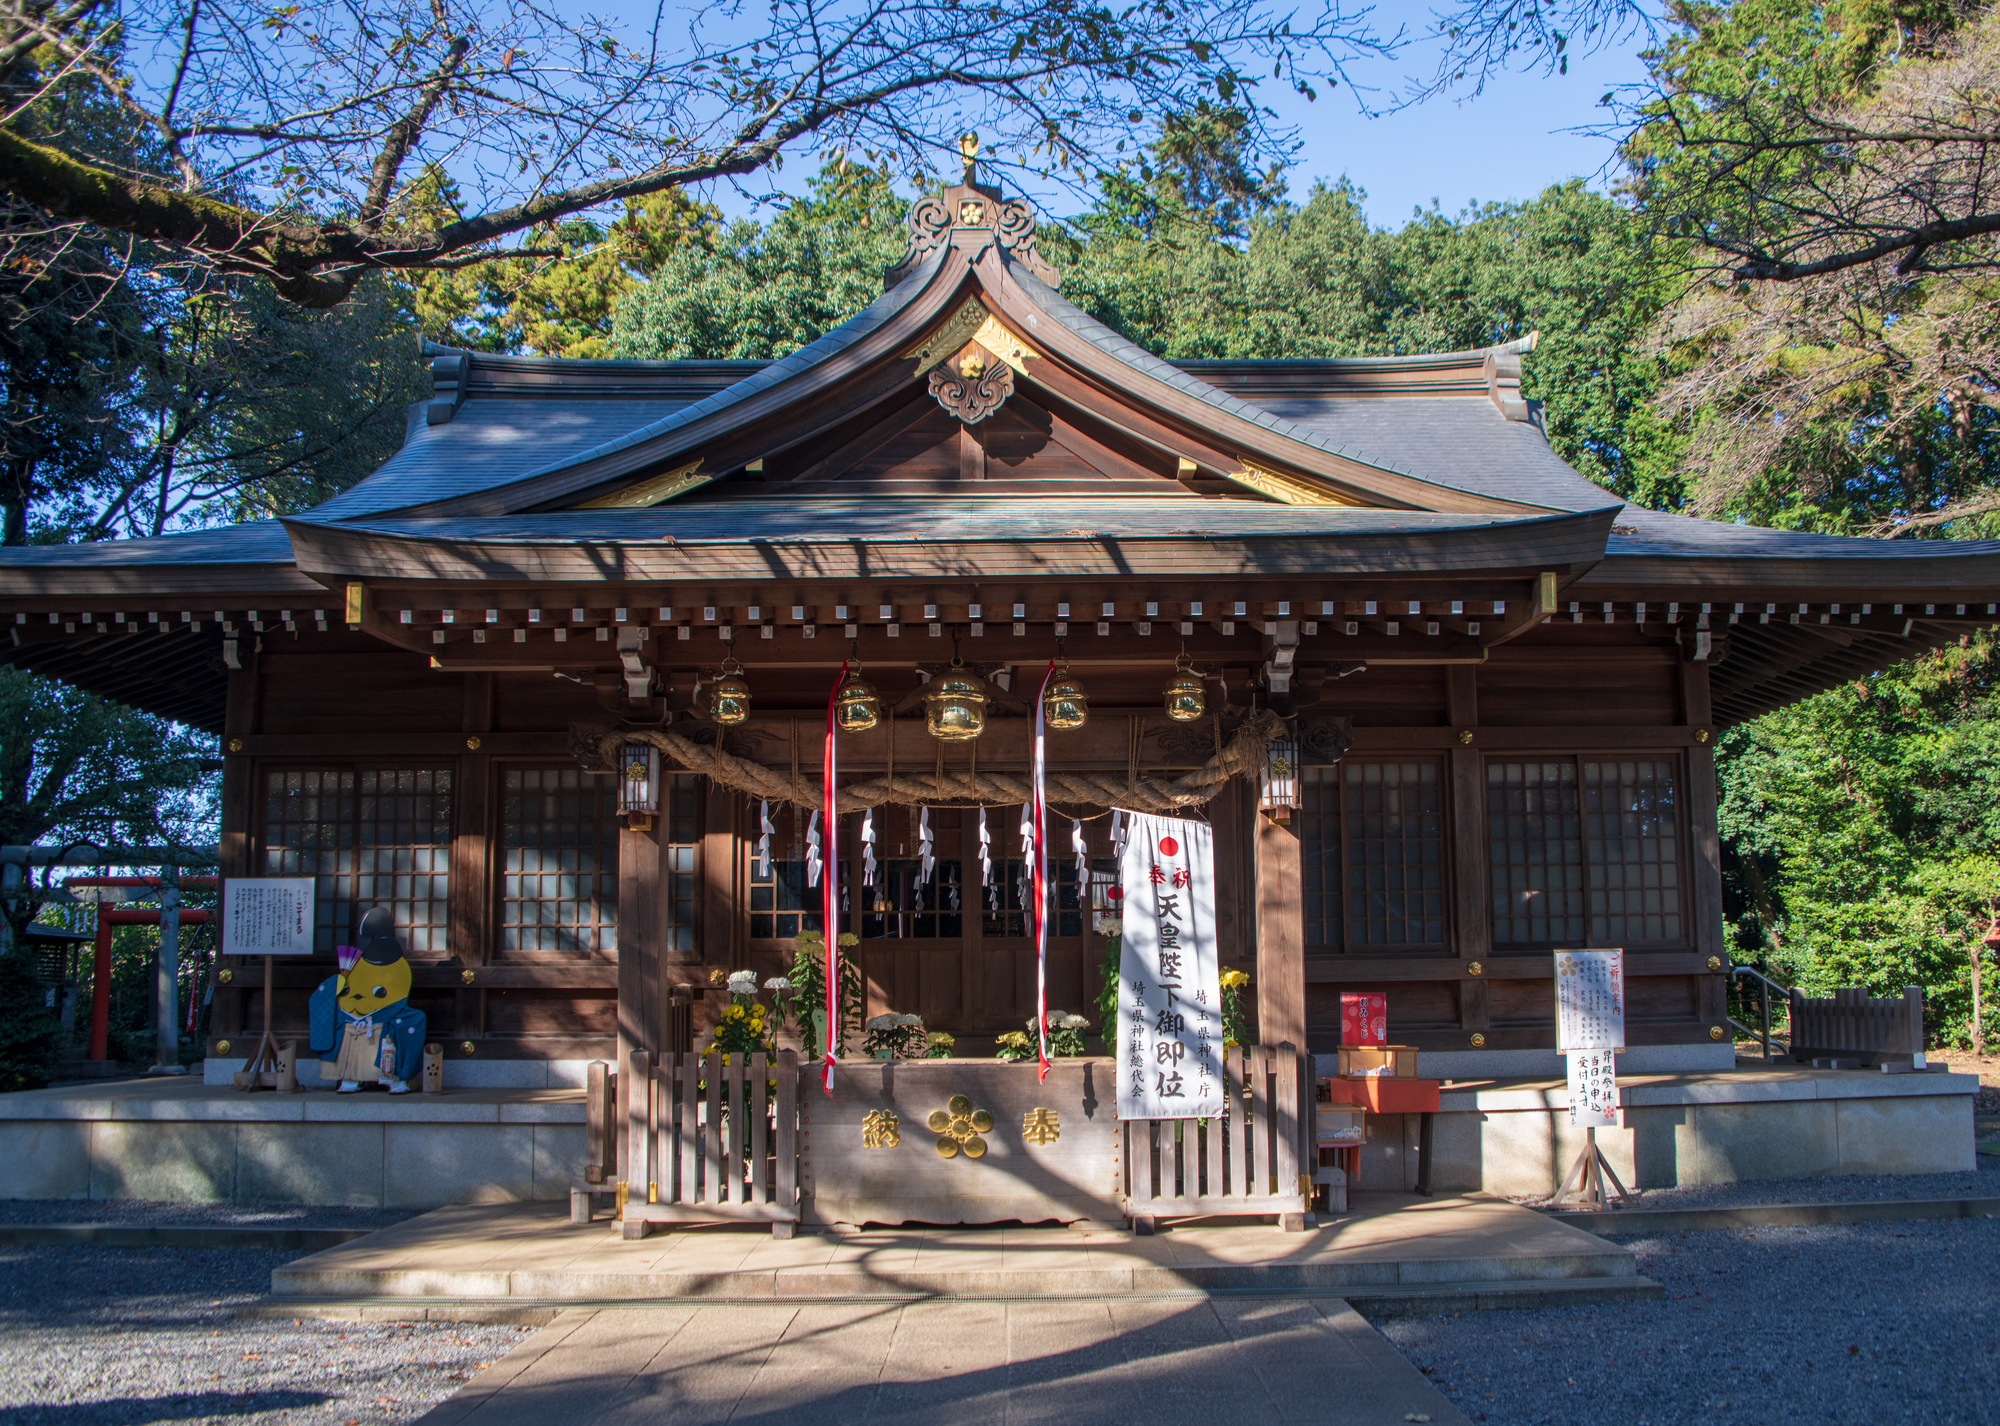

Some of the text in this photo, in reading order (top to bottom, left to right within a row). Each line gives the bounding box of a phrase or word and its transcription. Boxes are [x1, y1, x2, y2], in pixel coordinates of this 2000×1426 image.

[1148, 865, 1192, 892] 奉祝
[1155, 893, 1185, 1099] 天皇陛下御即位
[1610, 955, 1621, 1016] ご祈願案内
[1130, 981, 1145, 1098] 埼玉県神社総代会
[1195, 989, 1211, 1098] 埼玉県神社庁
[1359, 997, 1369, 1039] おみくじ
[1577, 1056, 1588, 1107] 受付ます
[1591, 1055, 1602, 1112] 当日の申込
[1601, 1050, 1613, 1102] 昇殿参拝
[862, 1107, 1060, 1148] 奉 納
